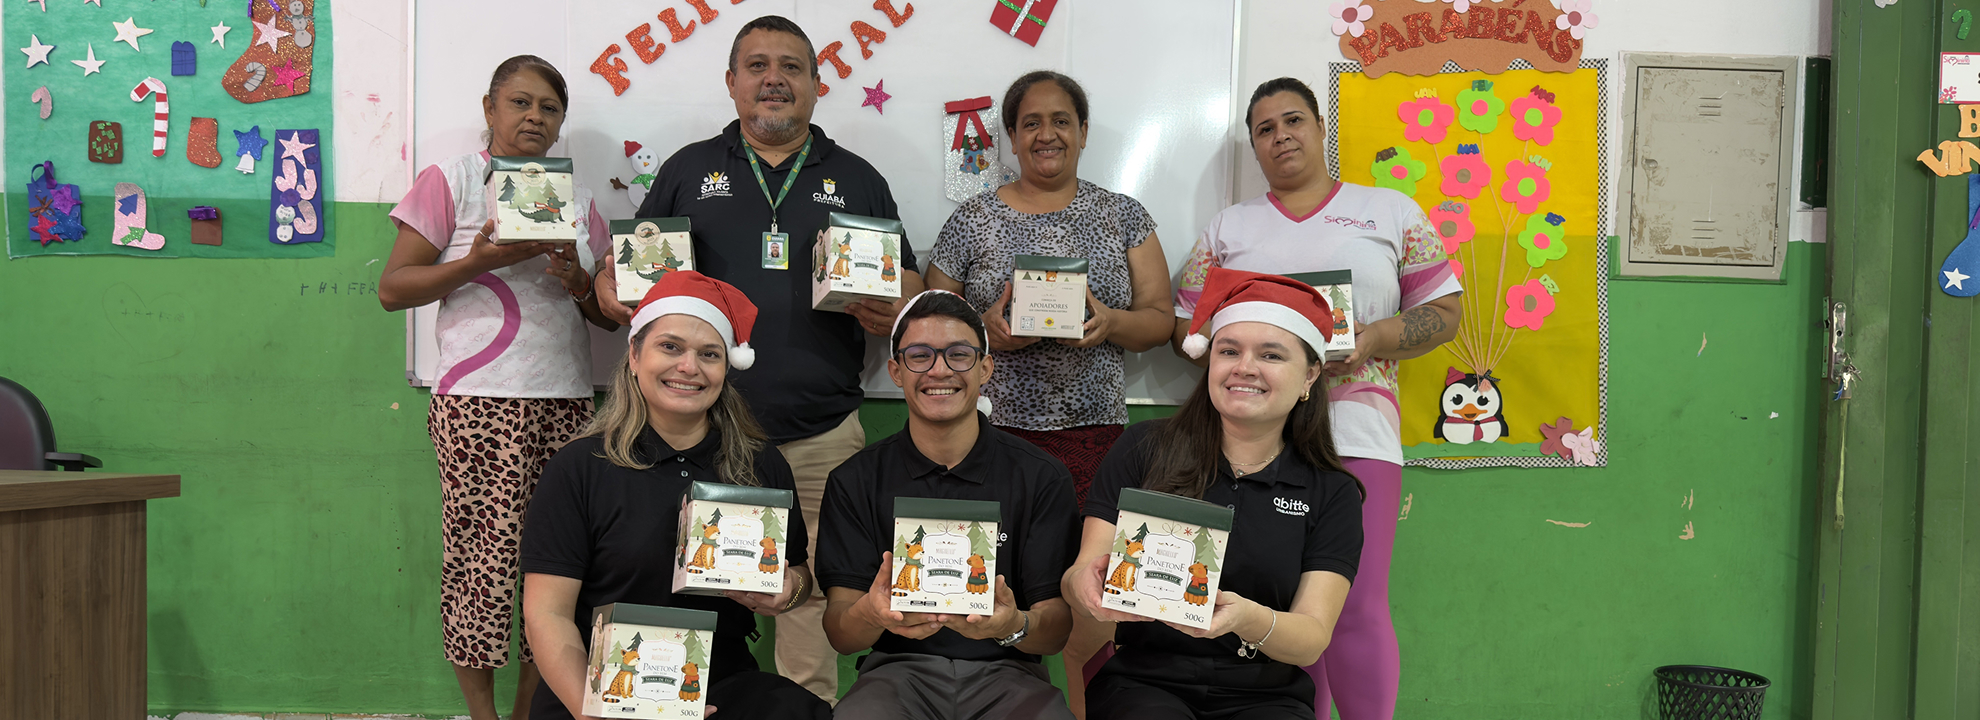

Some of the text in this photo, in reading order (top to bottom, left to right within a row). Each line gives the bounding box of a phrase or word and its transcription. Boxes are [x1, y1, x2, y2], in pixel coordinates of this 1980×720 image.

[1349, 0, 1580, 67] PARABÉNS
[1471, 79, 1494, 92] FEV
[1414, 88, 1438, 99] JAN
[1530, 85, 1556, 104] MAR
[1375, 146, 1398, 163] ABR
[1456, 143, 1480, 155] MAI
[1528, 154, 1552, 172] JUN
[701, 183, 730, 194] SARC
[813, 192, 846, 206] CUIABÁ
[1438, 200, 1464, 214] AGO
[1029, 302, 1069, 310] APOIADORES
[1273, 497, 1310, 513] abitte
[723, 536, 756, 546] PANETONE
[928, 555, 963, 566] PANETONE
[1147, 556, 1186, 572] PANETONE
[968, 602, 988, 610] 500G
[1183, 612, 1205, 623] 500G
[643, 662, 678, 673] PANETONE
[680, 709, 699, 717] 500G
